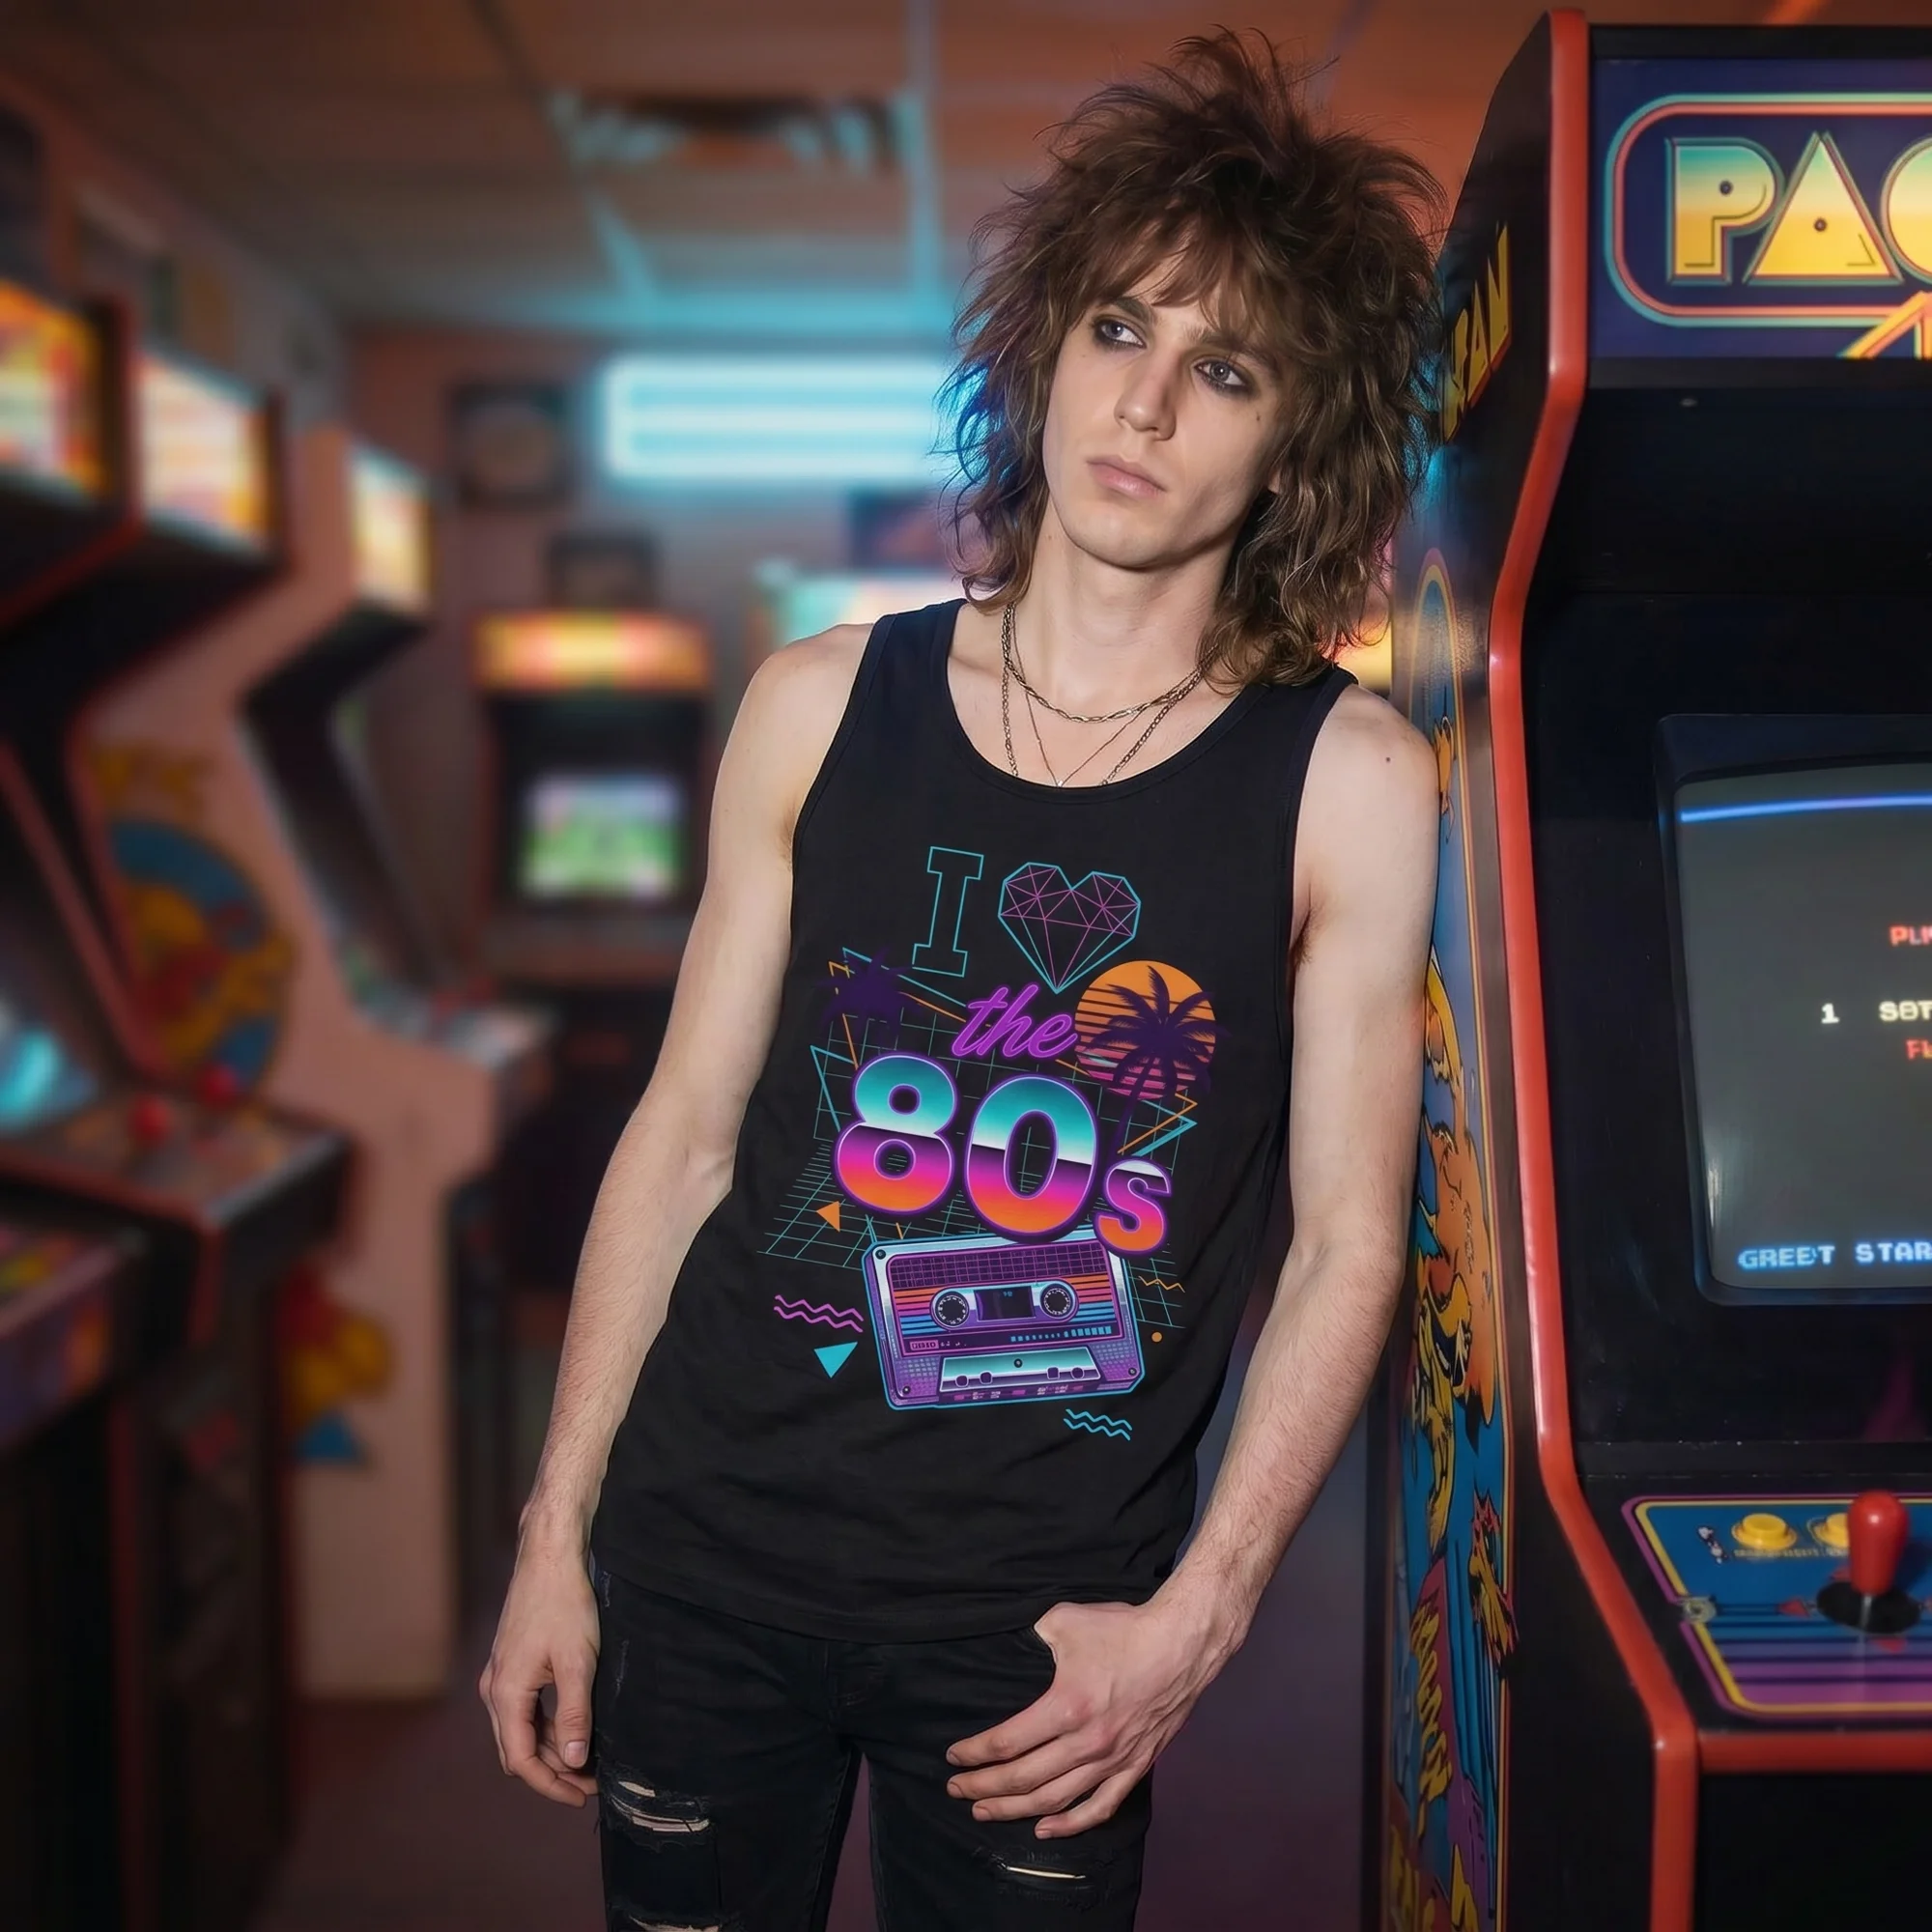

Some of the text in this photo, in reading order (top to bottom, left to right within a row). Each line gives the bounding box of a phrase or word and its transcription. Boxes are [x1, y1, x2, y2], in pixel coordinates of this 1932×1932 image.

[912, 846, 984, 978] I
[951, 983, 1078, 1059] the
[1821, 1003, 1840, 1024] 1
[834, 1052, 1173, 1256] 80s
